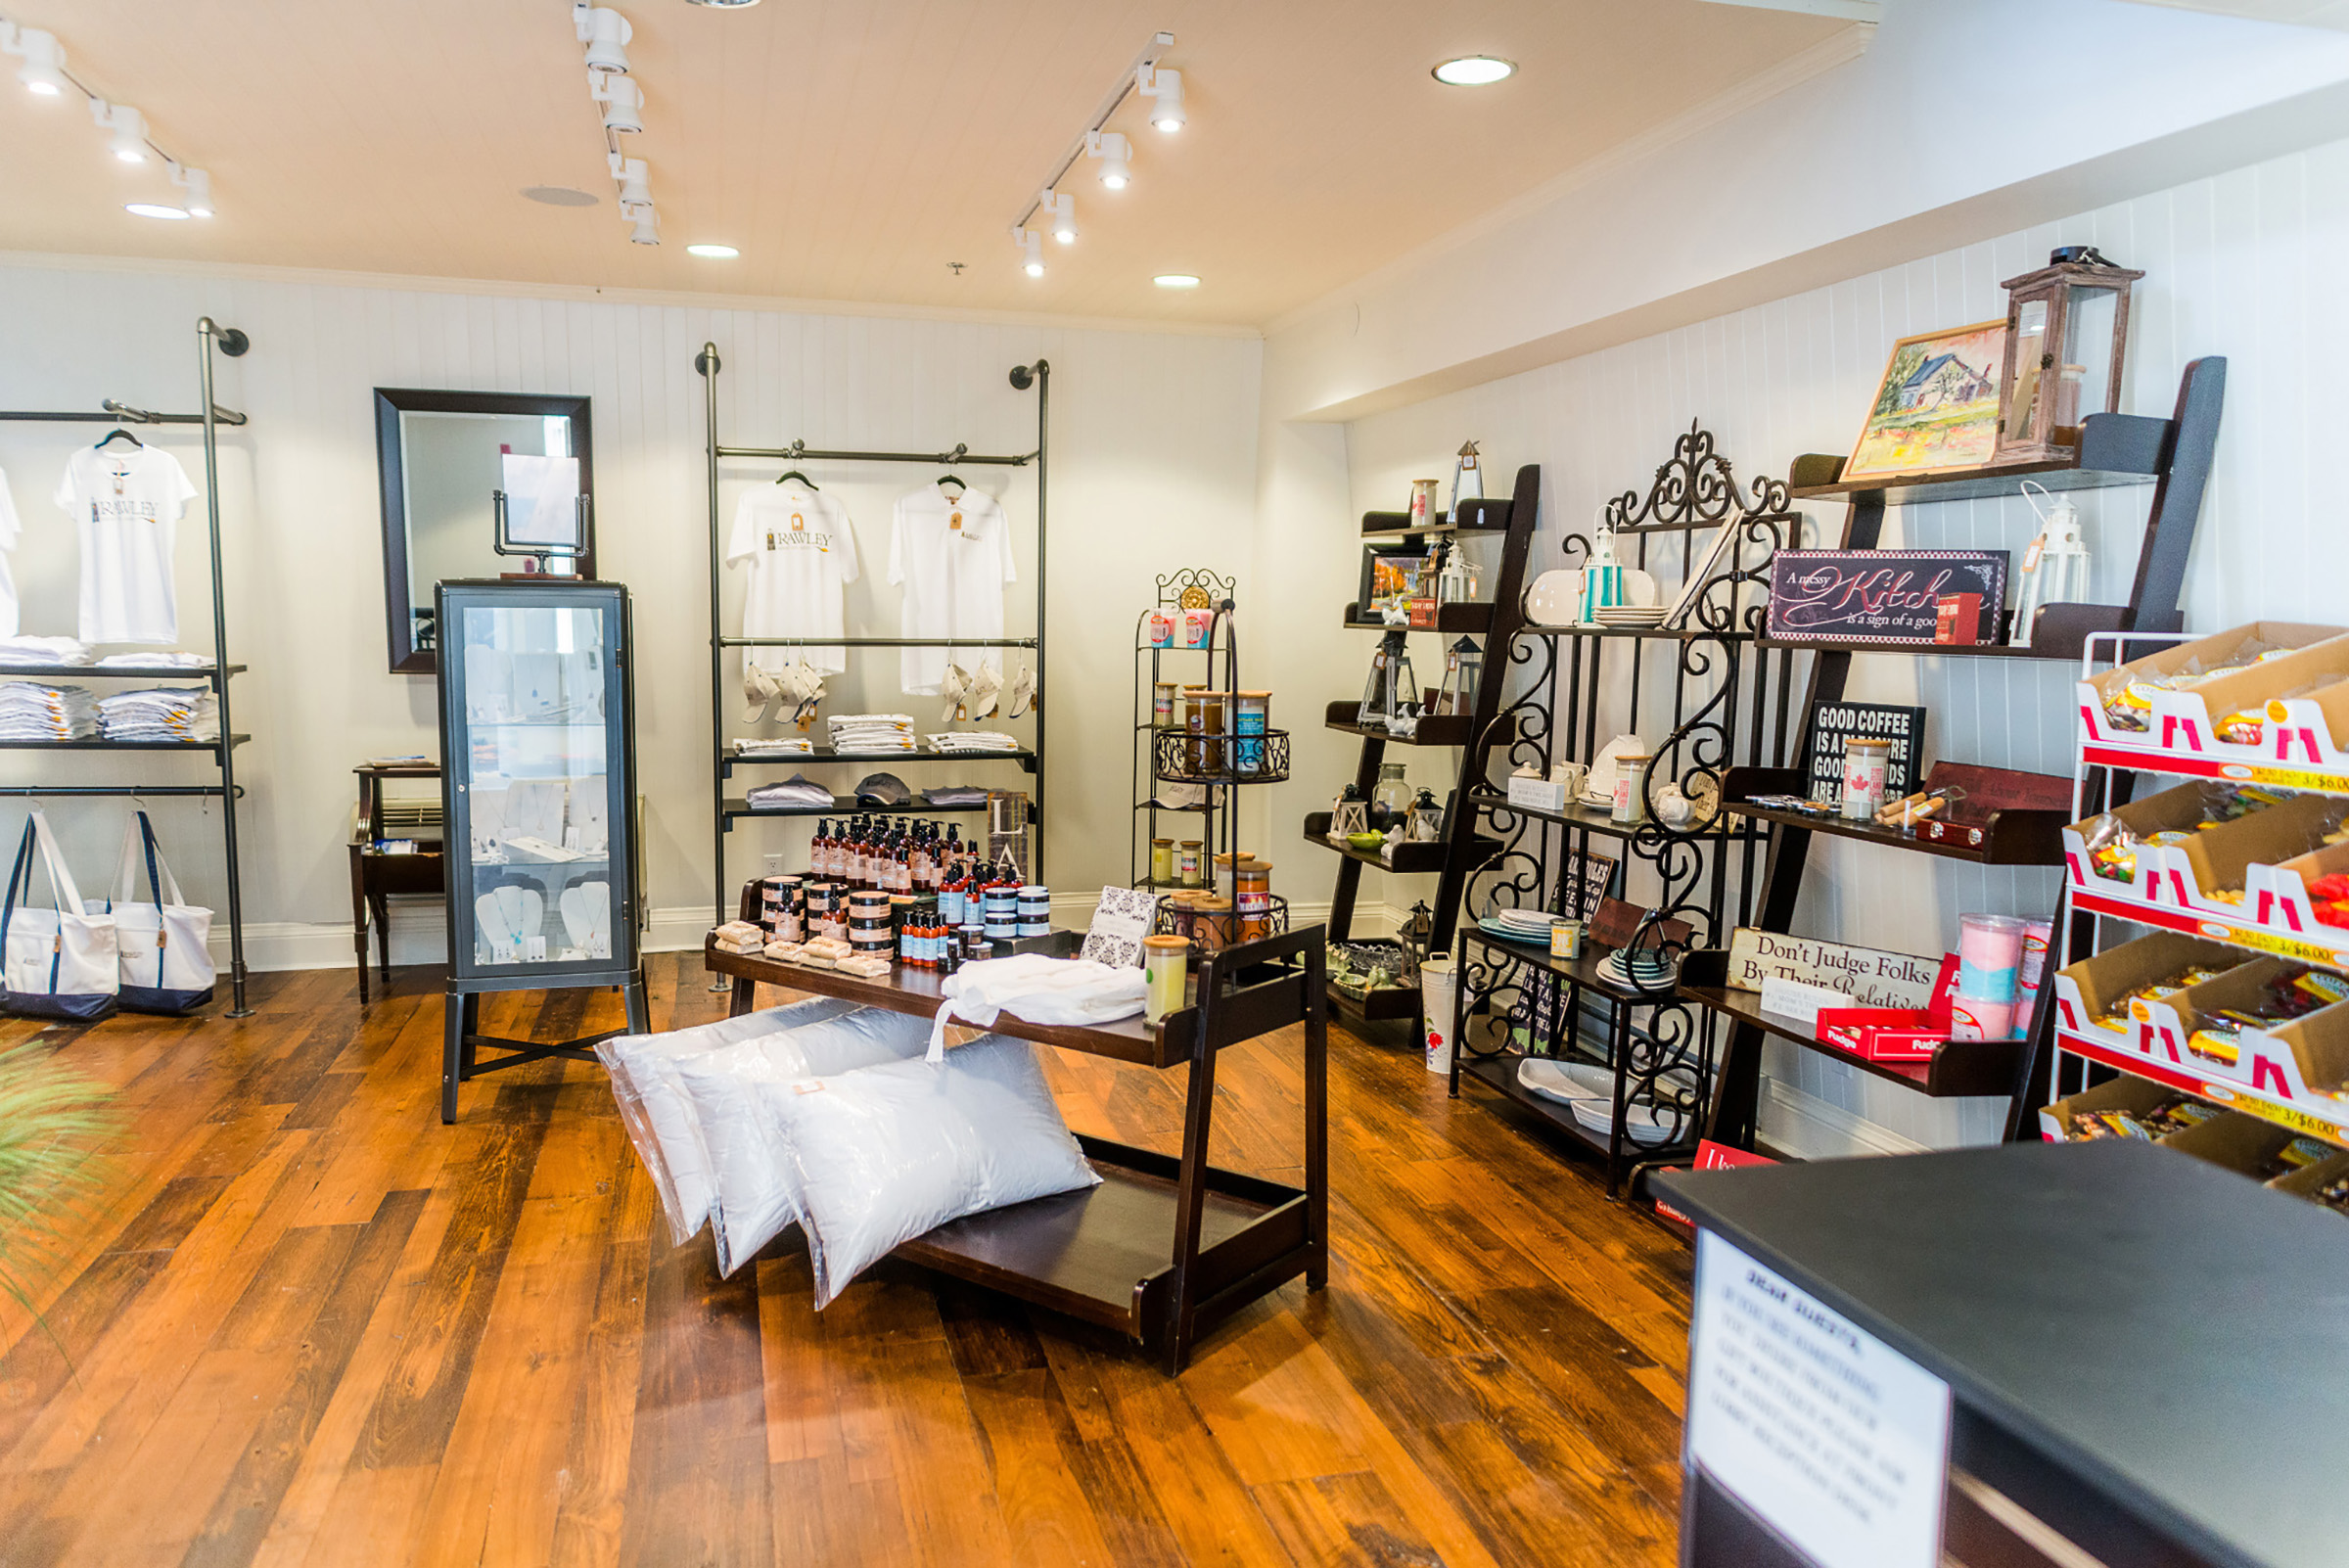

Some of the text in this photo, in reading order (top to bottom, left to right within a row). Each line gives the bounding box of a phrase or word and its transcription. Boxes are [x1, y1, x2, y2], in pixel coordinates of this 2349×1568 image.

[778, 532, 834, 546] RAWLEY
[1786, 573, 1831, 588] A messy
[1846, 612, 1937, 629] is a sign of a goo
[1819, 707, 1911, 735] GOOD COFFEE
[1816, 731, 1829, 753] IS
[1830, 732, 1840, 754] A
[1812, 780, 1834, 802] ARE
[1757, 935, 1810, 963] Don't
[1813, 945, 1870, 976] Judge
[1876, 956, 1931, 985] Folks
[1742, 959, 1769, 986] By
[1774, 965, 1828, 990] Their
[1827, 1029, 1858, 1049] Fudge
[1911, 1038, 1941, 1051] Fud
[2283, 1109, 2335, 1136] 3/$6.00
